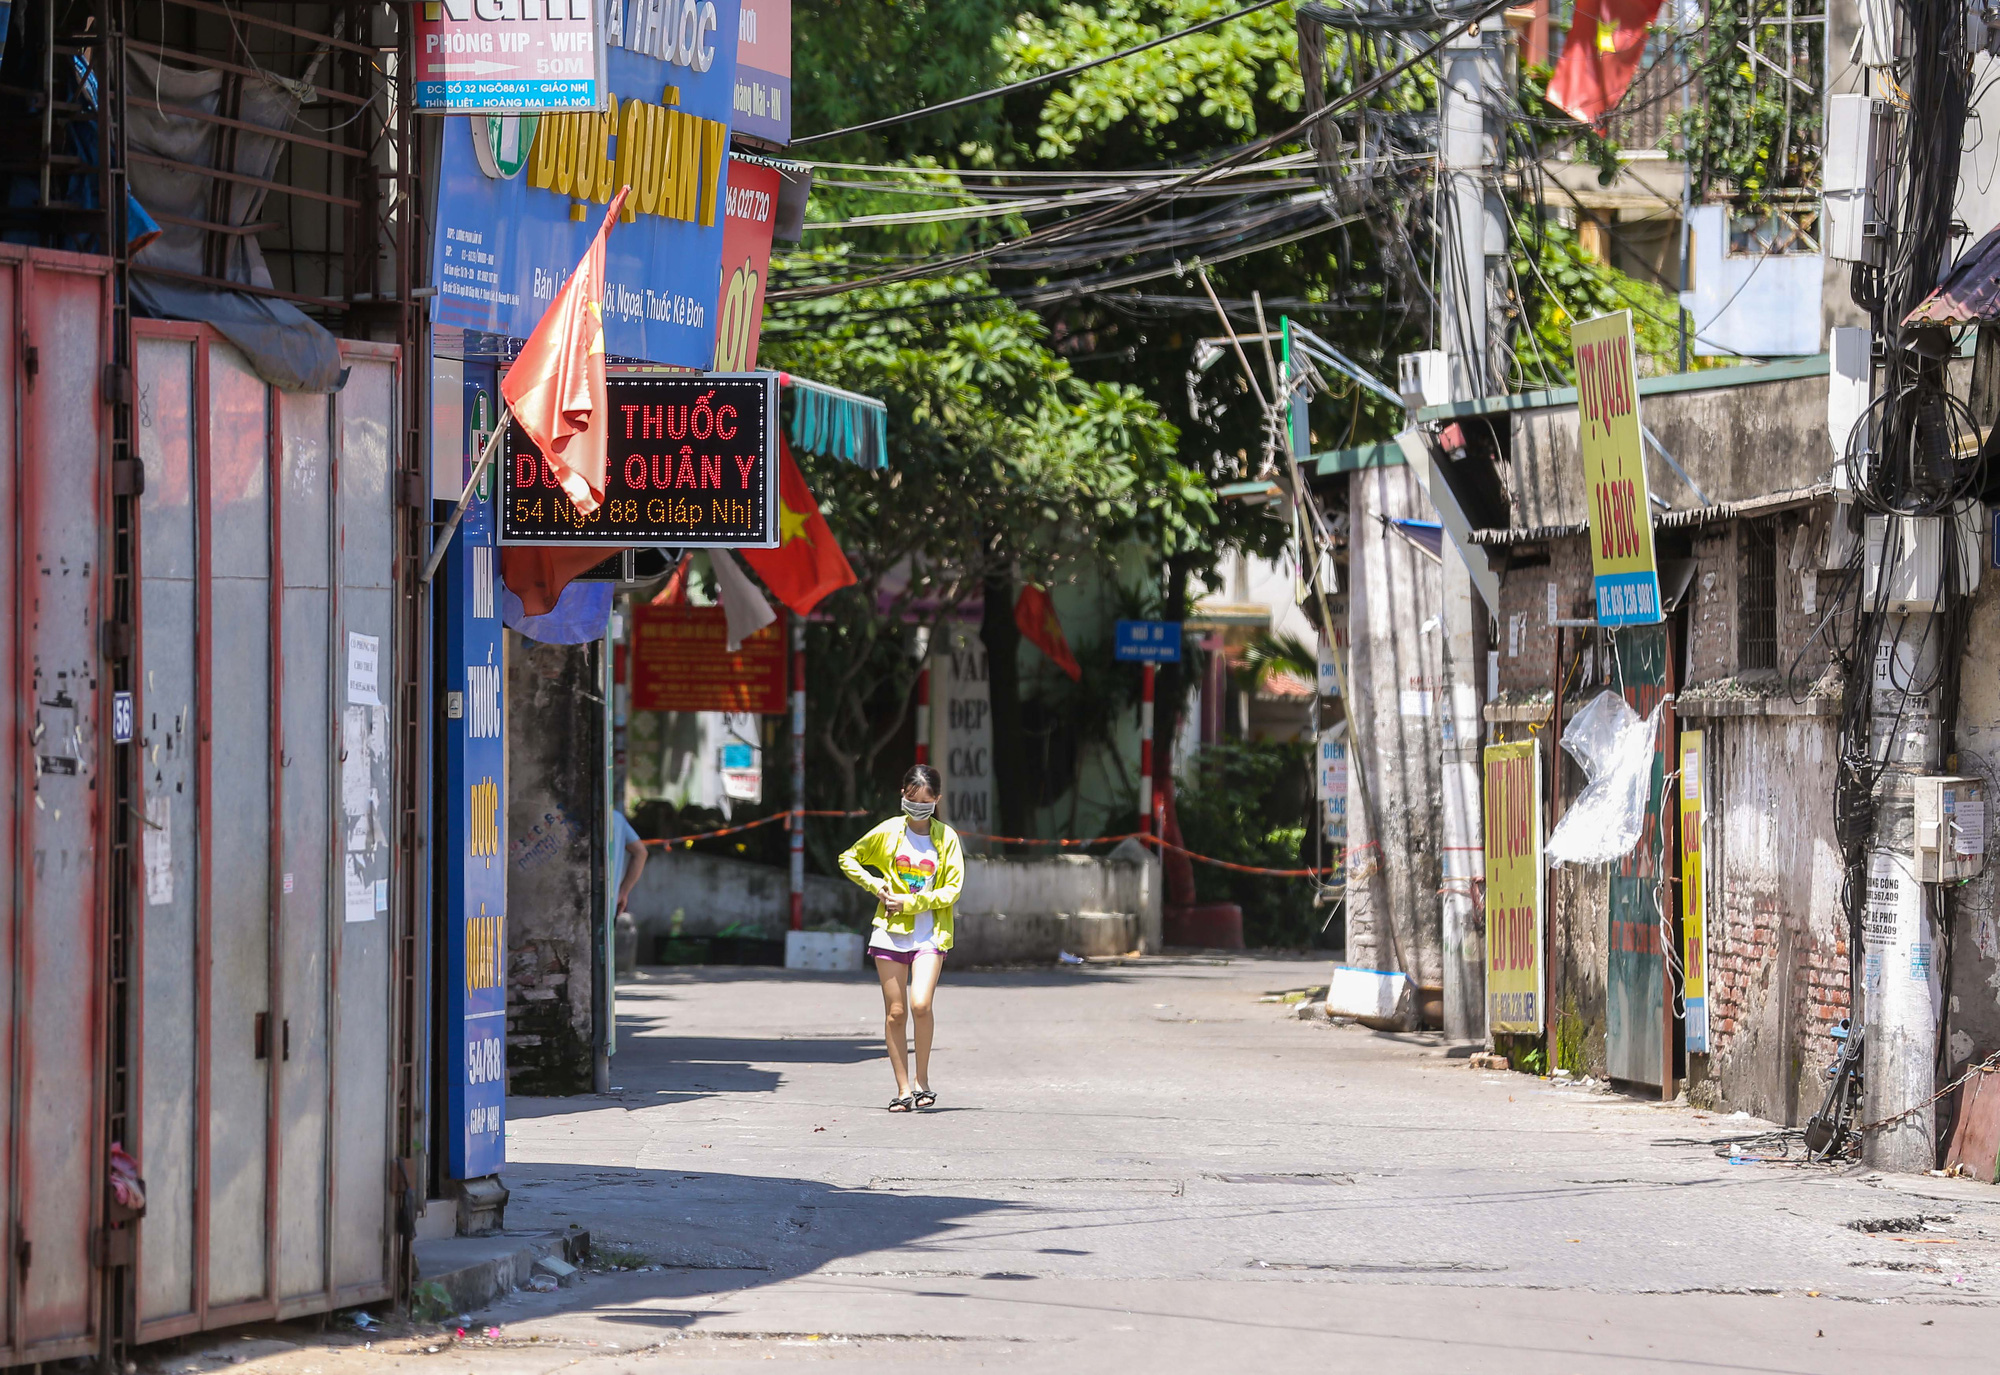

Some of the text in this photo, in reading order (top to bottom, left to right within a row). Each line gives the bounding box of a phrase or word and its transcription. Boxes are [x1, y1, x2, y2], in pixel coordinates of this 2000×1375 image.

[426, 29, 493, 53] PHÒNG
[500, 32, 530, 52] VIP
[550, 31, 593, 52] WIFI
[427, 85, 445, 94] ĐC:
[448, 82, 462, 94] SỐ
[464, 84, 476, 93] 32
[536, 58, 584, 74] 50M
[483, 96, 522, 108] HOÀNG
[525, 98, 545, 108] MAI
[554, 95, 573, 107] HÀ
[738, 188, 752, 220] 027
[753, 191, 770, 223] 720
[533, 267, 552, 301] Bán
[646, 290, 671, 322] Thuốc
[673, 294, 685, 325] Kê
[686, 297, 704, 328] Đơn
[1598, 335, 1631, 437] QUAY
[620, 390, 738, 440] THUỐC
[624, 445, 722, 490] QUÂN
[734, 455, 756, 489] Y
[516, 499, 544, 523] 54
[609, 499, 638, 523] 88
[473, 532, 494, 619] NHÀ
[467, 642, 500, 738] THUỐC
[116, 699, 131, 730] 56
[1506, 756, 1533, 870] QUAY
[465, 902, 503, 1000] QUÂN Y
[1491, 892, 1535, 972] LÒ ĐÚC
[469, 1037, 501, 1085] 54/88
[469, 1103, 486, 1137] GIÁP
